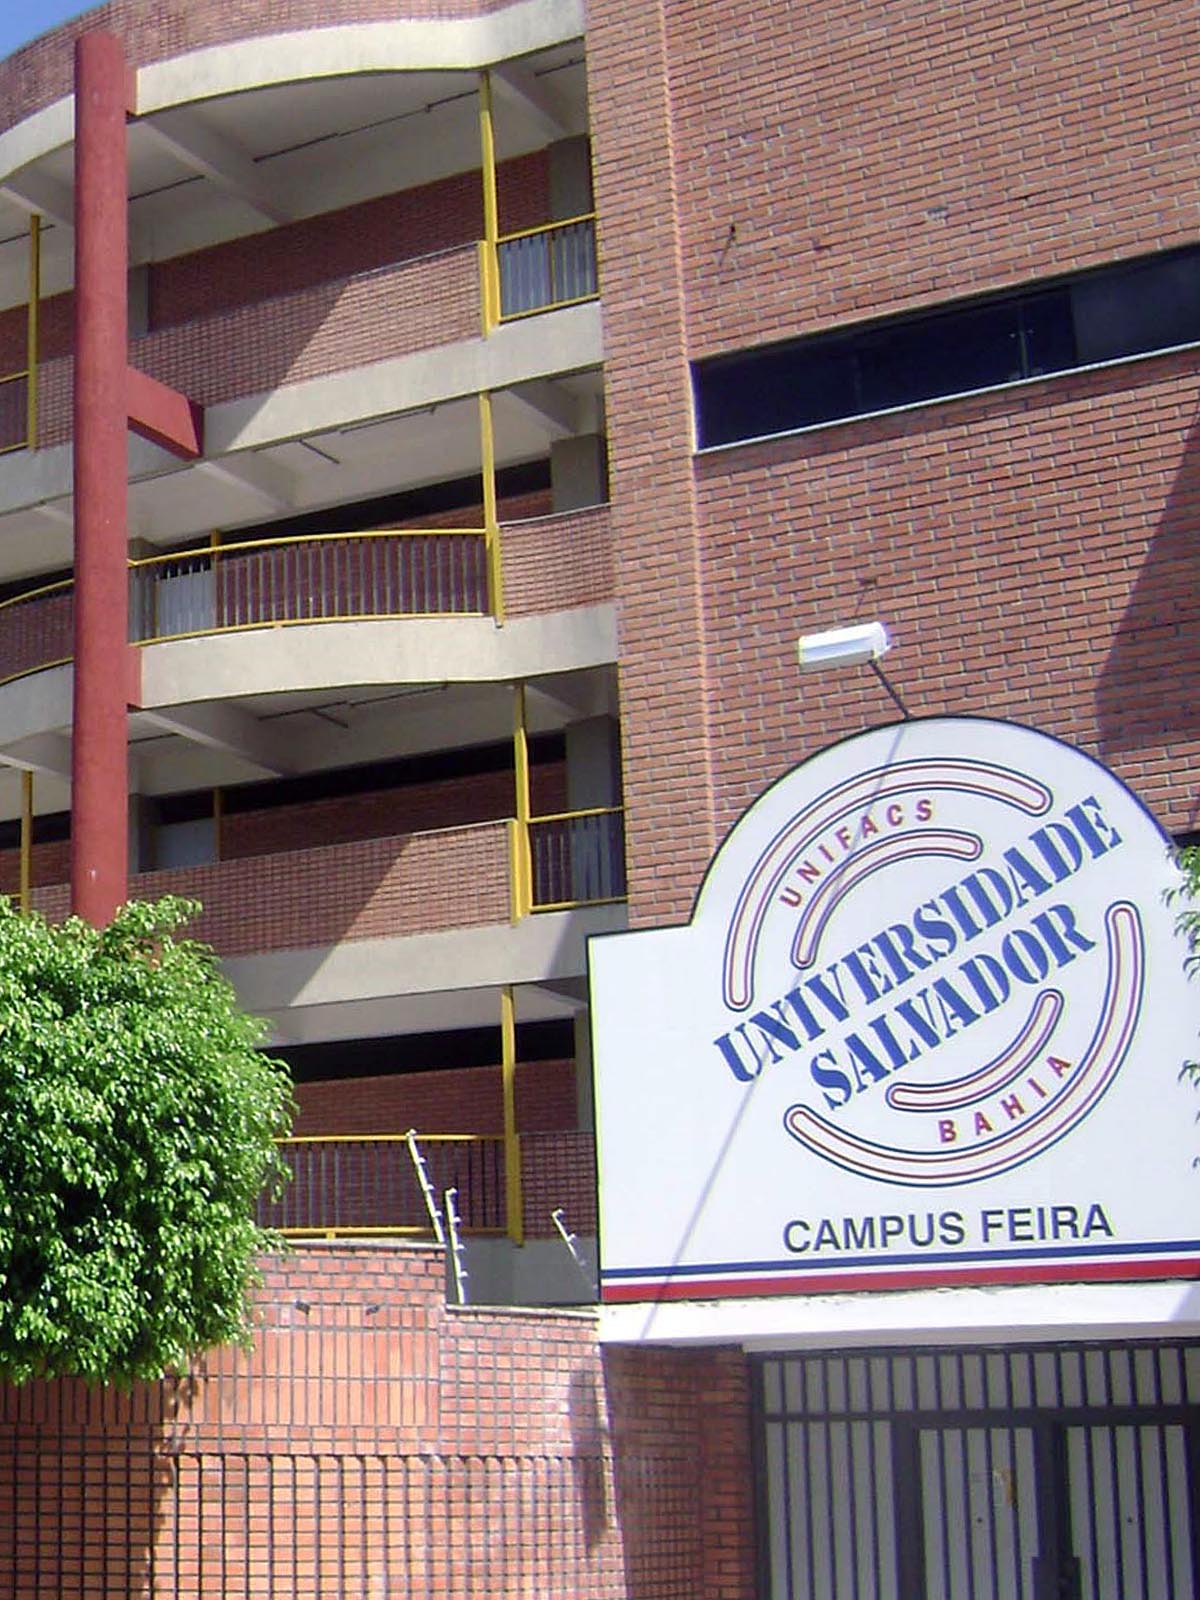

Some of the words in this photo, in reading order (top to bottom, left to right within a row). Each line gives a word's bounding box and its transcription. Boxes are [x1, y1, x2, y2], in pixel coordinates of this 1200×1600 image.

[781, 799, 933, 908] UNIFACS
[714, 796, 1122, 1083] UNIVERSIDADE
[810, 903, 1097, 1110] SALVADOR
[938, 1055, 1072, 1143] BAHIA
[783, 1210, 966, 1253] CAMPUS
[981, 1205, 1114, 1245] FEIRA
